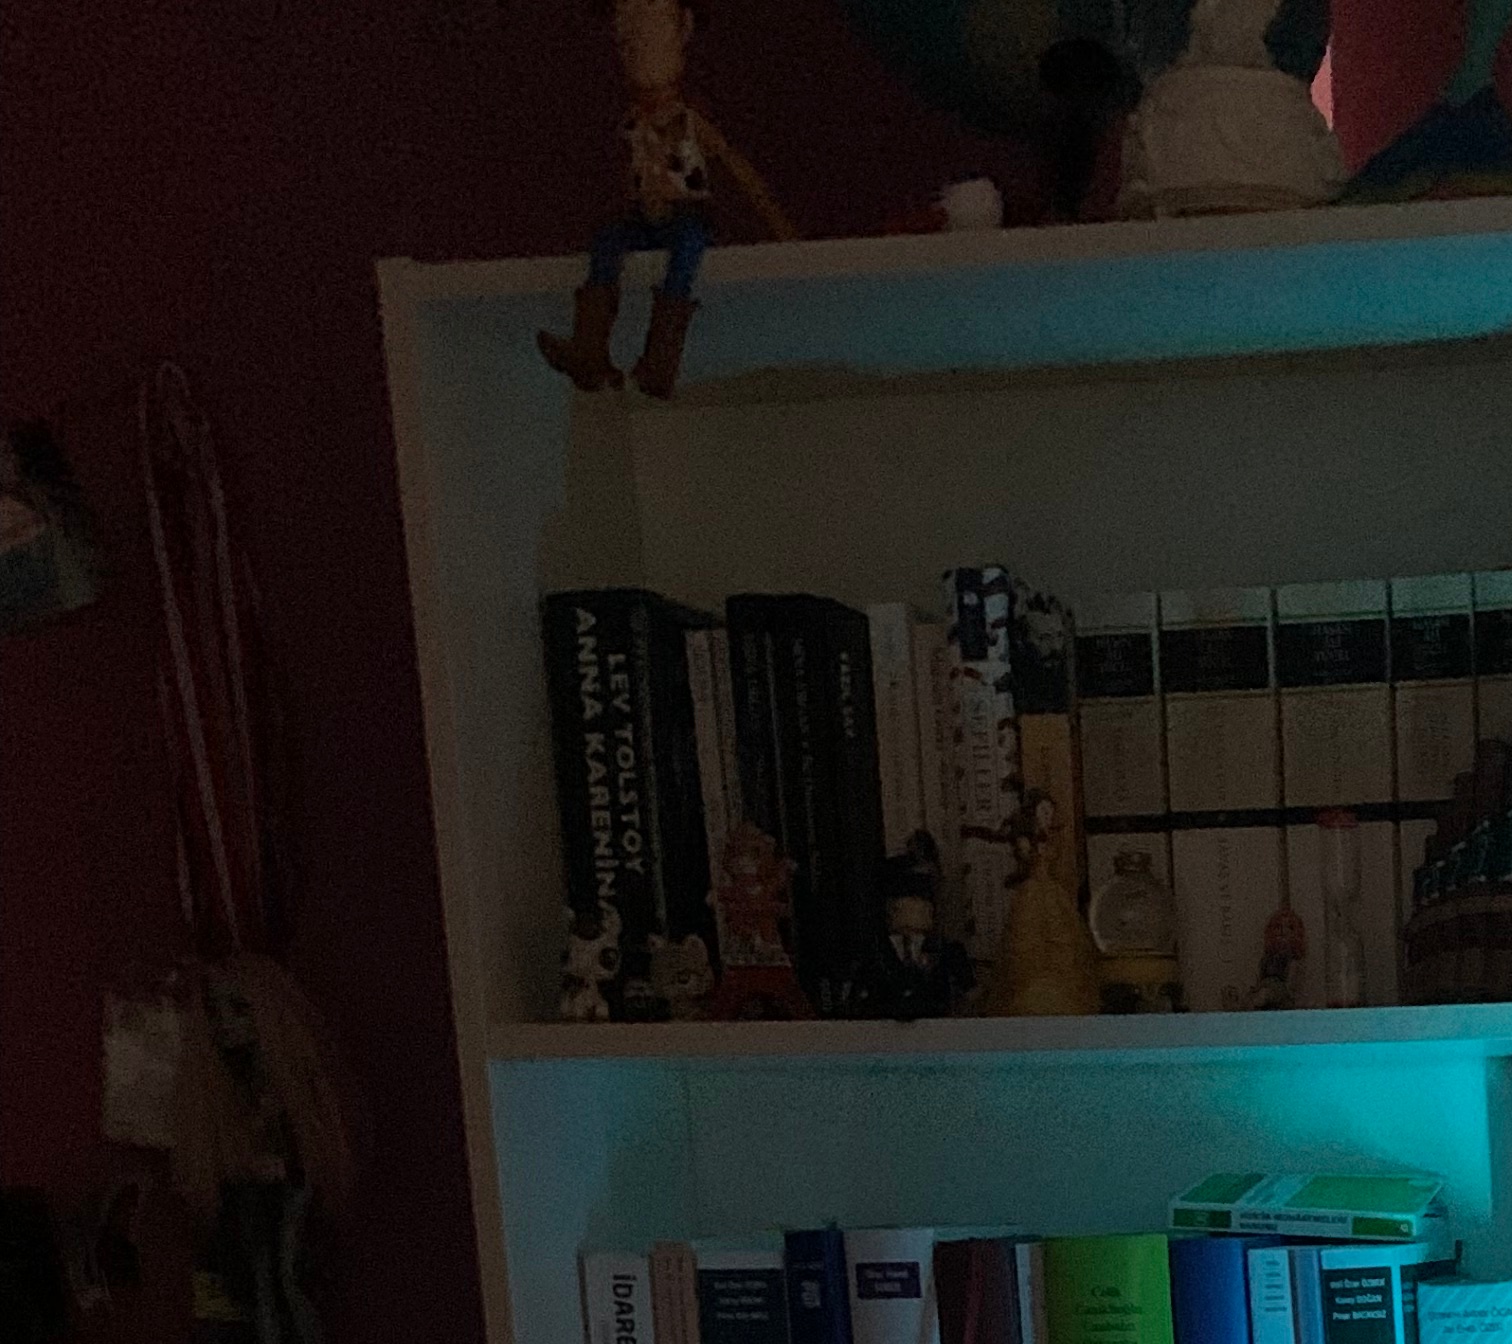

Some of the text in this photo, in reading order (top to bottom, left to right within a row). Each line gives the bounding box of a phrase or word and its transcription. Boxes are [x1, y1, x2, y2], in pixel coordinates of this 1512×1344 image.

[575, 606, 600, 720] ANNA
[607, 653, 645, 875] LEV TOLSTOY
